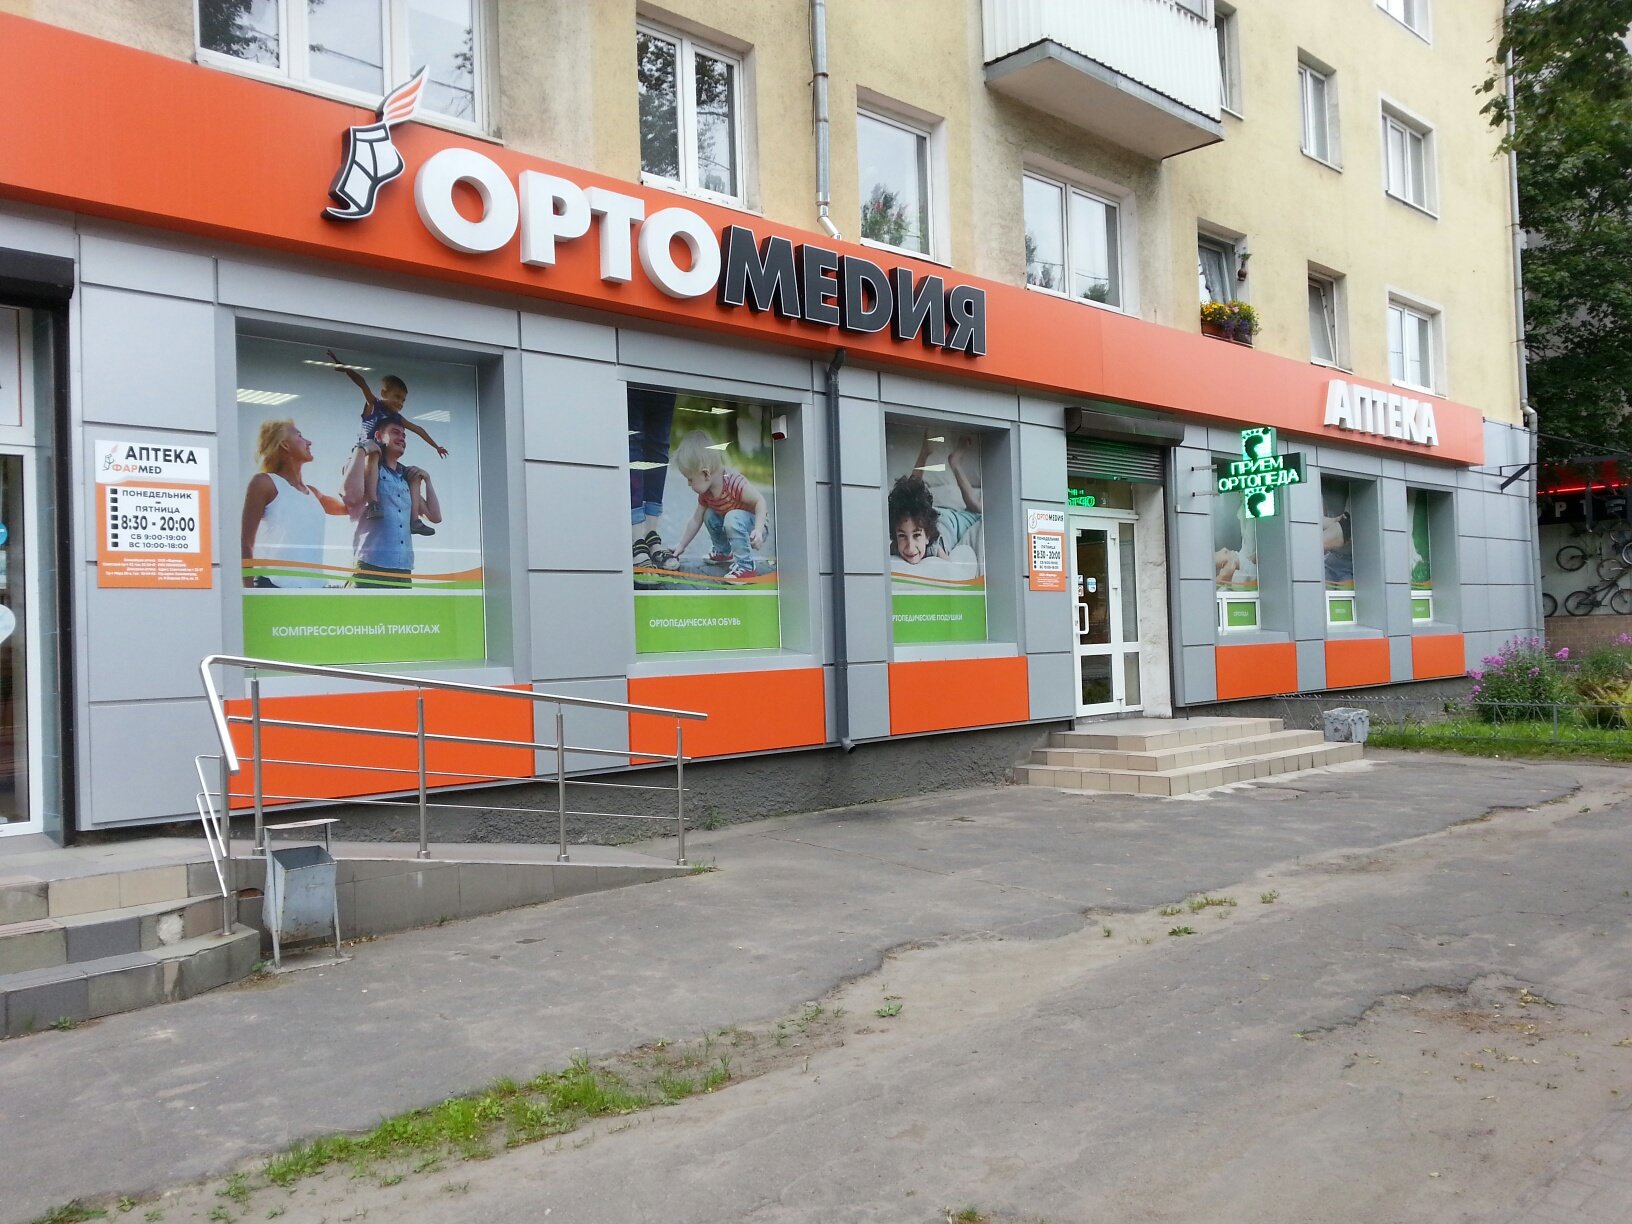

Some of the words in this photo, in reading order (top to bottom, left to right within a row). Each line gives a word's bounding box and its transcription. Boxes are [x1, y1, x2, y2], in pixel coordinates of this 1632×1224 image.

[1323, 378, 1440, 447] АПТЕКА
[125, 445, 198, 464] АПТЕКА
[1230, 455, 1284, 475] ПРИЕМ
[1218, 468, 1300, 491] ОРТОПЕДА
[122, 489, 192, 500] ПОНЕДЕЛЬНИК
[135, 505, 181, 514] ПЯТНИЦА
[121, 515, 148, 530] 8:30
[160, 516, 195, 532] 20:00
[649, 618, 716, 628] ОРТОПЕДИЧЕСКАЯ
[717, 617, 741, 626] ОБУВЬ
[892, 614, 936, 622] РТОПЕДИЧЕСКИЕ
[272, 623, 386, 637] КОМПРЕССИОННЫЙ
[387, 624, 441, 634] ТРИКОТАЖ
